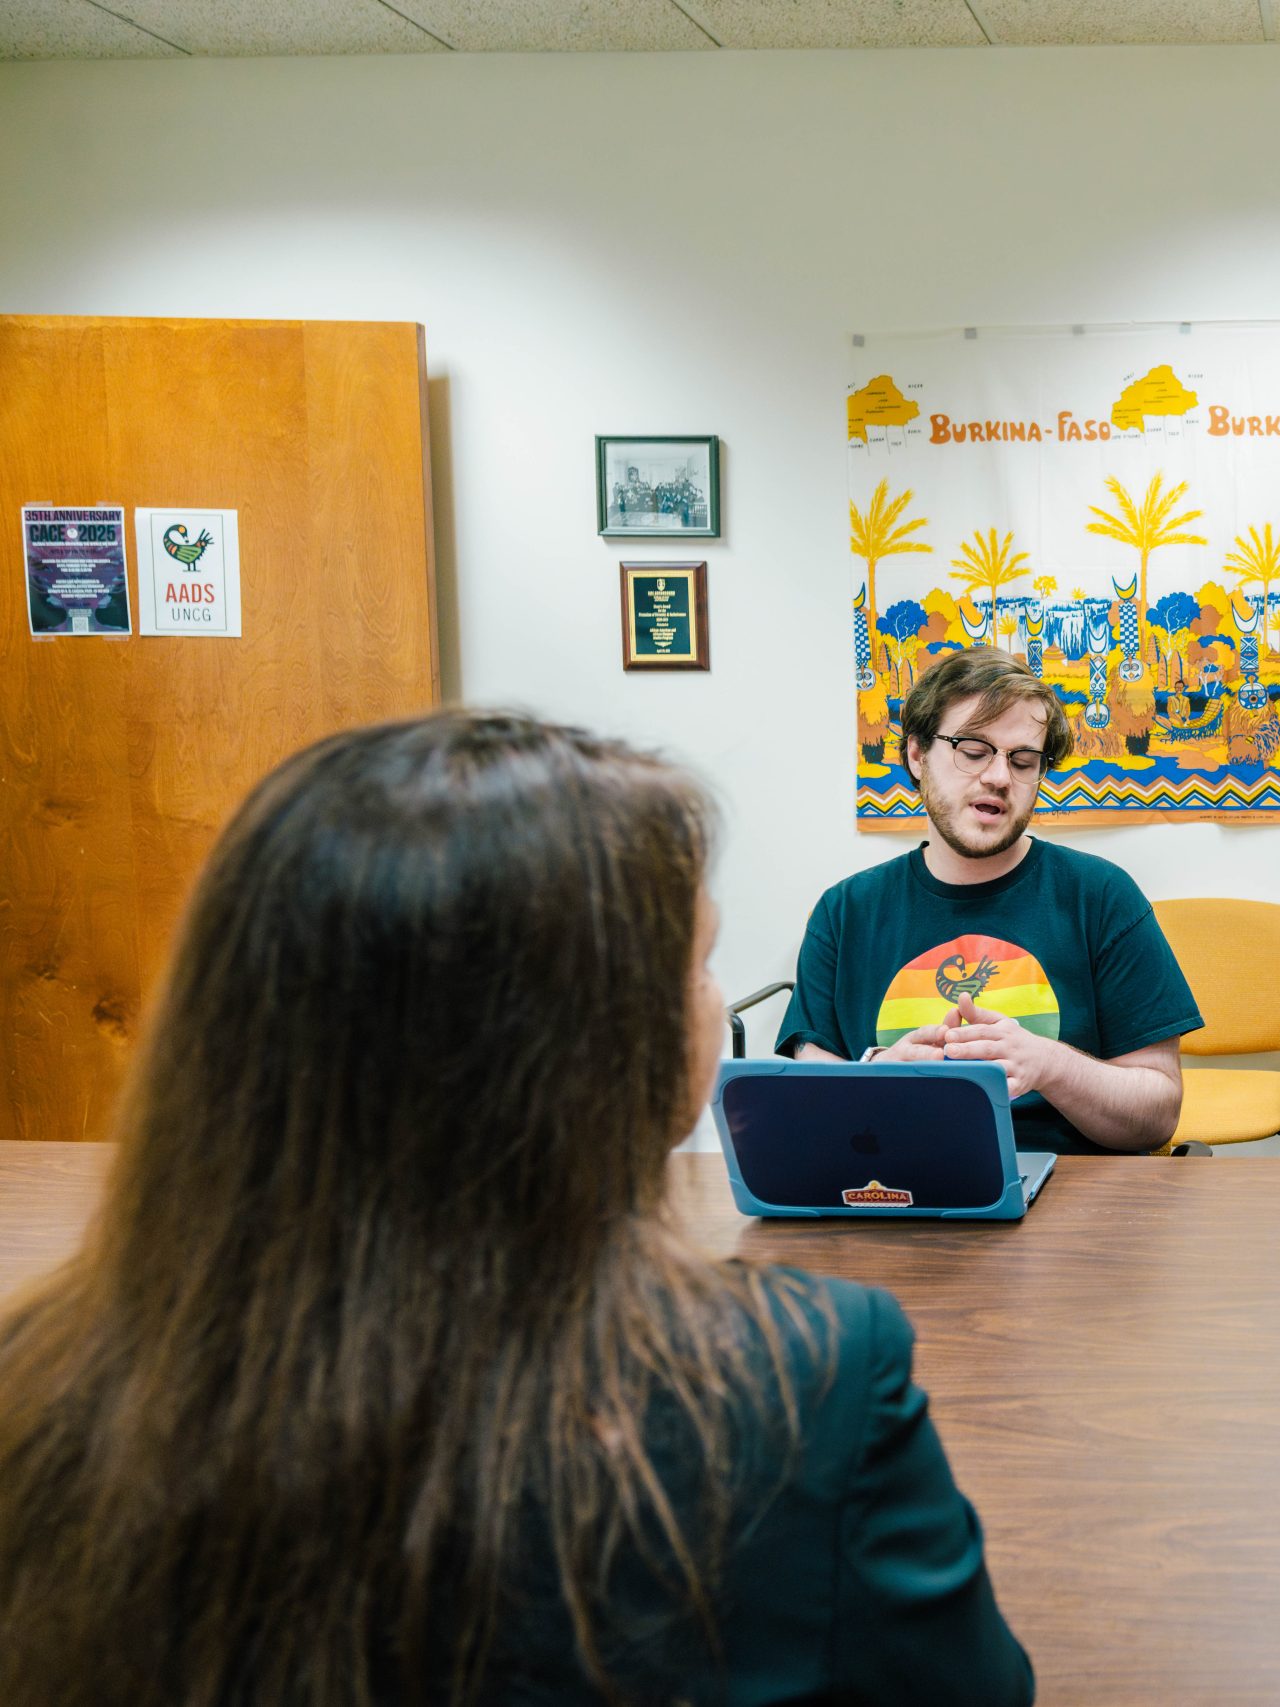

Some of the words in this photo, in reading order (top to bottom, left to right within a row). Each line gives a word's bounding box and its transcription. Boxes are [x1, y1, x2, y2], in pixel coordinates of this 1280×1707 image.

[25, 511, 51, 521] 35TH
[53, 510, 121, 521] ANNIVERSARY
[30, 525, 66, 542] CACE
[78, 524, 116, 542] 2025
[166, 583, 215, 603] AADS
[172, 608, 211, 621] UNCG
[848, 1191, 907, 1200] CAROLINA
